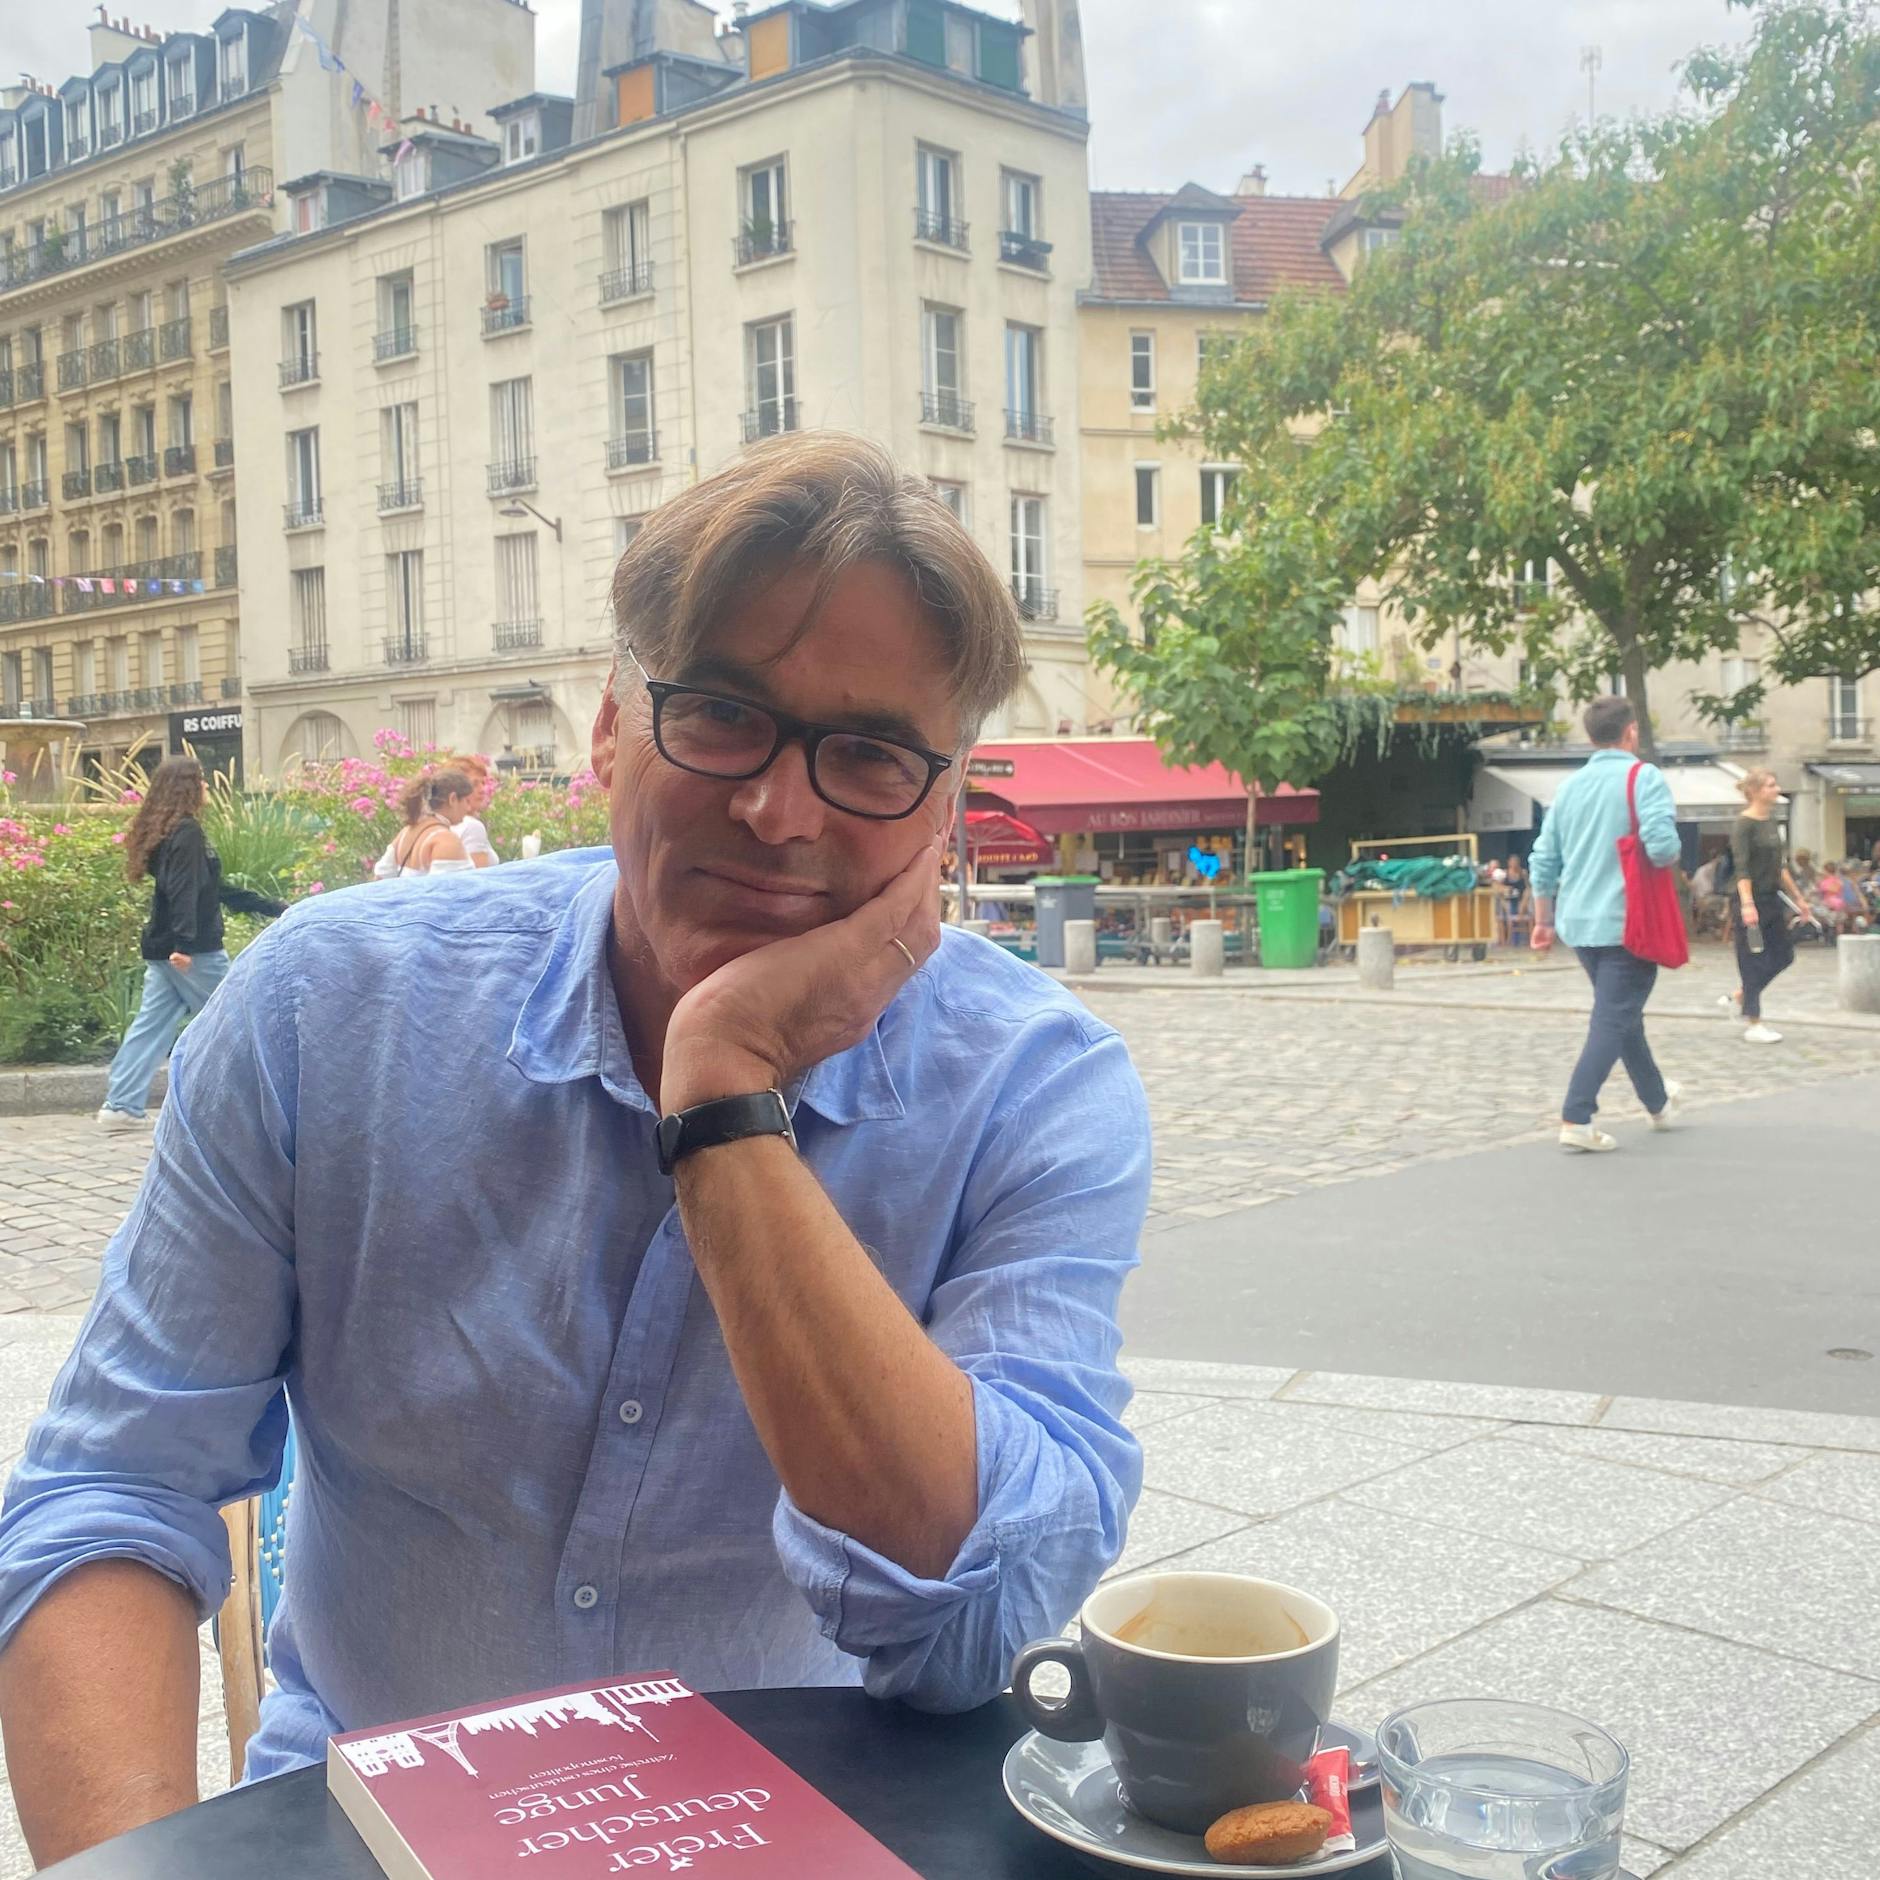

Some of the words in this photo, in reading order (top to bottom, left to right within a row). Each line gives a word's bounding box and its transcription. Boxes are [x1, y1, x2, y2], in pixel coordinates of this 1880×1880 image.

[183, 717, 199, 733] RS
[488, 1774, 582, 1800] ostdeutschen
[582, 1764, 617, 1776] eines
[494, 1773, 652, 1825] Junge
[515, 1787, 771, 1858] deutscher
[607, 1822, 772, 1873] Freier
